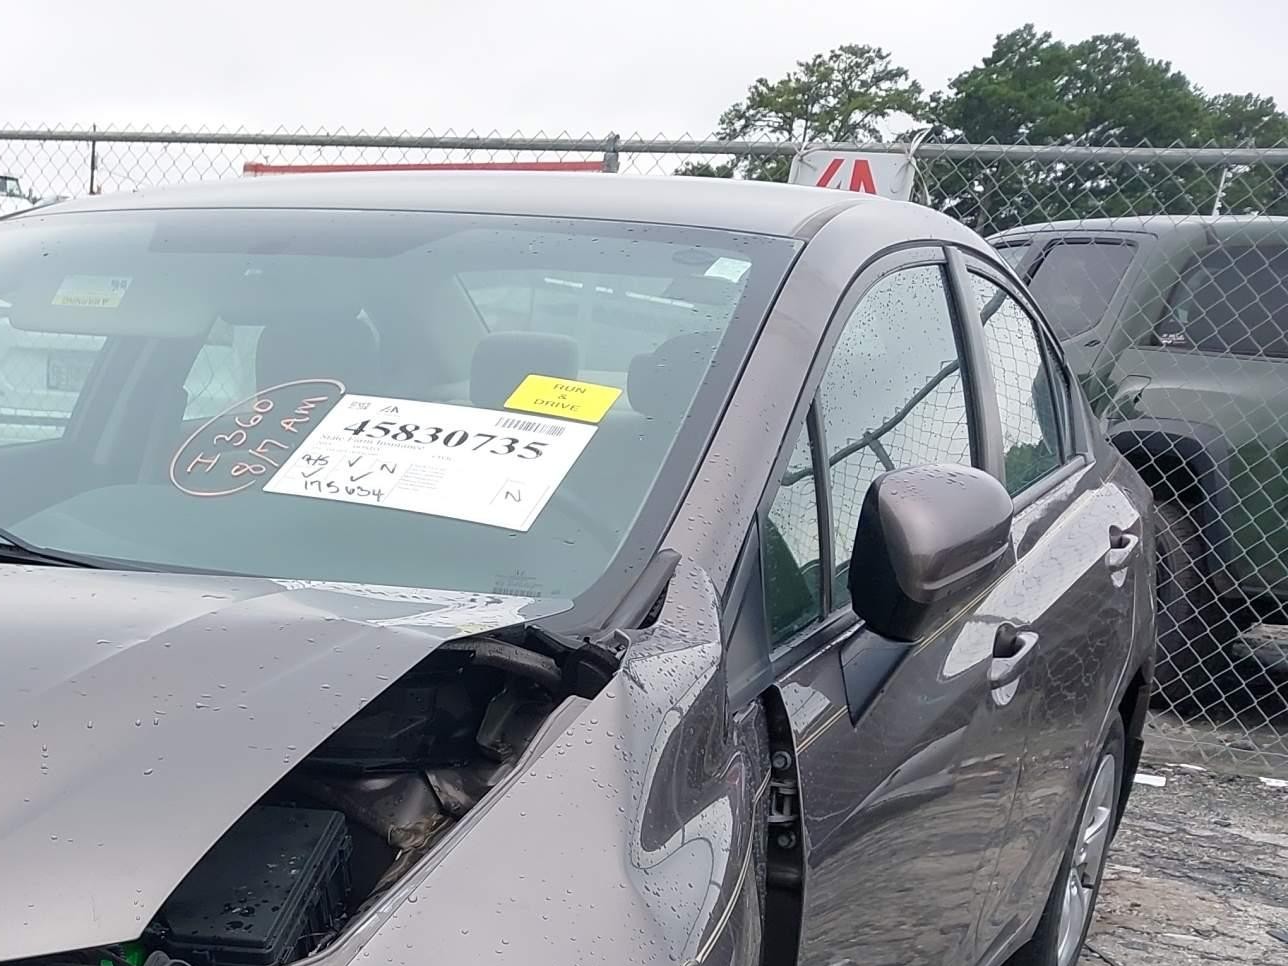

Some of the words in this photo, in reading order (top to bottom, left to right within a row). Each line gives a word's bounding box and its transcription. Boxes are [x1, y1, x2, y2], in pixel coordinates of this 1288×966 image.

[553, 383, 587, 394] RUN
[533, 399, 583, 412] DRIVE
[343, 418, 550, 461] 45830735
